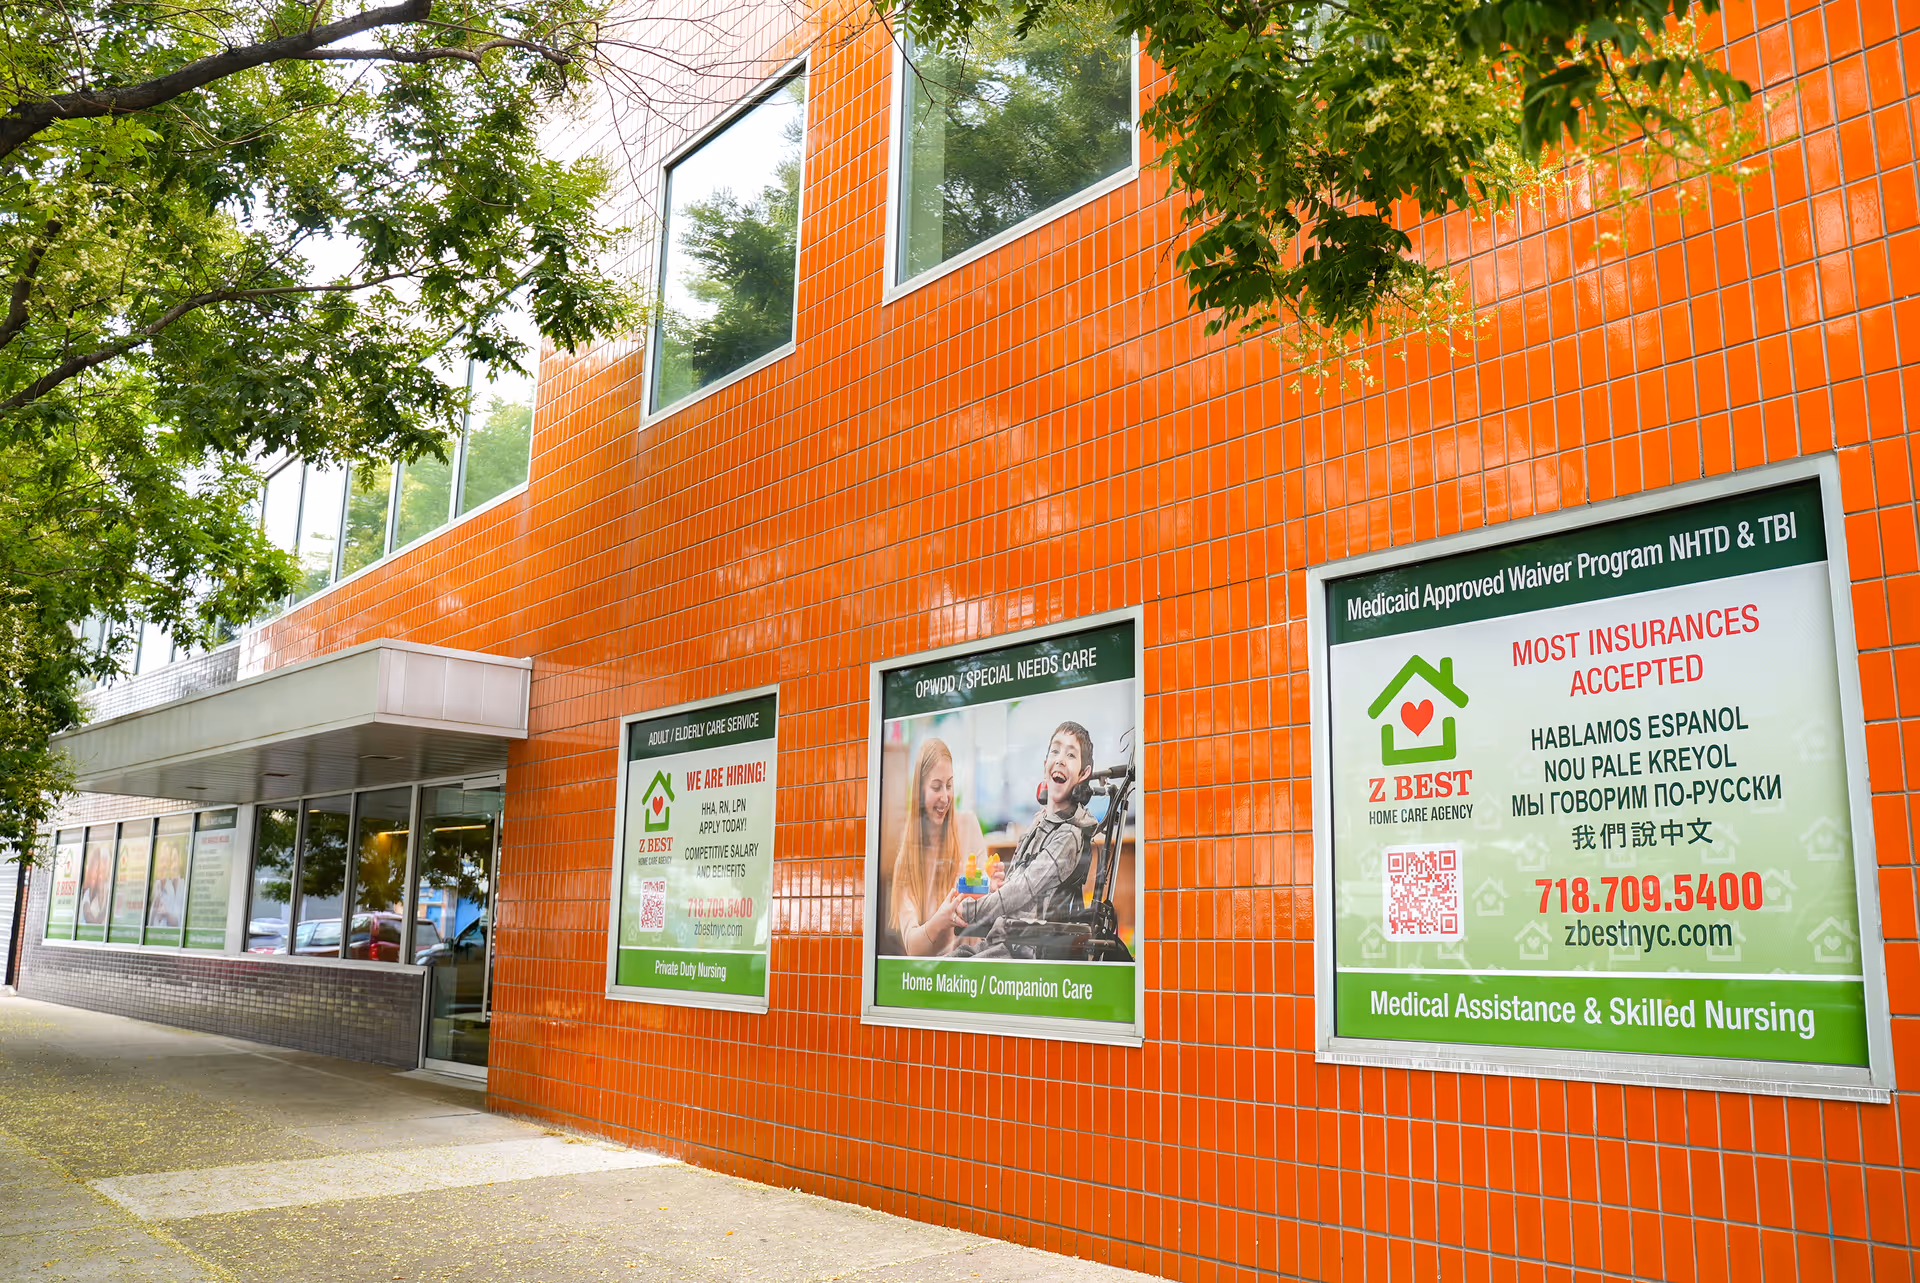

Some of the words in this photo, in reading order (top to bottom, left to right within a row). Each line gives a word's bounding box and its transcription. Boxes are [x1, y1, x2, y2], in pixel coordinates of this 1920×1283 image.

[1347, 583, 1419, 621] Medicaid
[1423, 569, 1504, 610] Approved
[1508, 559, 1572, 593] Waiver
[1577, 542, 1663, 579] Program
[1669, 525, 1730, 561] NHTD
[1737, 521, 1755, 548] &
[1759, 511, 1797, 543] TBI
[1513, 632, 1580, 667] MOST
[1589, 604, 1759, 656] INSURANCES
[916, 675, 955, 698] OPWDD
[958, 674, 964, 691] /
[966, 664, 1013, 689] SPECIAL
[1017, 655, 1058, 679] NEEDS
[1062, 647, 1096, 671] CARE
[1569, 654, 1703, 696] ACCEPTED
[648, 729, 669, 746] ADULT
[670, 728, 674, 742] /
[676, 723, 705, 741] ELDERLY
[706, 719, 725, 736] CARE
[727, 712, 759, 732] SERVICE
[1532, 716, 1641, 750] HABLAMOS
[1649, 706, 1748, 739] ESPANOL
[687, 770, 701, 791] WE
[704, 768, 723, 789] ARE
[727, 761, 766, 786] HIRING!
[1544, 757, 1585, 783] NOU
[1592, 751, 1642, 779] PALE
[1649, 744, 1736, 774] KREYOL
[1369, 778, 1386, 802] Z
[1394, 770, 1472, 801] BEST
[1513, 792, 1544, 817] МЫ
[1551, 782, 1647, 814] ГОВОРИМ
[1655, 775, 1782, 807] ПО-РУССКИ
[701, 802, 717, 816] HHA,
[719, 800, 730, 814] RN,
[733, 799, 746, 812] LPN
[1369, 807, 1399, 824] HOME
[1401, 806, 1428, 823] CARE
[1431, 804, 1473, 821] AGENCY
[699, 821, 721, 834] APPLY
[722, 818, 746, 832] TODAY!
[1572, 817, 1713, 850] 我們說中文
[638, 857, 648, 865] HOME
[649, 857, 657, 865] CARE
[658, 856, 672, 864] AGENCY
[639, 839, 645, 853] Z
[648, 837, 673, 852] BEST
[685, 845, 728, 860] COMPETITIVE
[731, 843, 759, 858] SALARY
[696, 865, 711, 878] AND
[712, 864, 745, 877] BENEFITS
[688, 898, 752, 917] 718.709.5400
[1535, 871, 1763, 913] 718.709.5400
[694, 922, 742, 939] zbestnyc.com
[1565, 919, 1732, 952] zbestnyc.com
[655, 960, 678, 976] Private
[680, 962, 696, 979] Duty
[698, 963, 726, 981] Nursing
[902, 972, 932, 991] Home
[936, 974, 977, 998] Making
[981, 976, 986, 994] /
[989, 976, 1058, 1000] Companion
[1062, 979, 1093, 999] Care
[1370, 990, 1449, 1018] Medical
[1455, 993, 1575, 1023] Assistance
[1584, 999, 1601, 1023] &
[1610, 996, 1695, 1029] Skilled
[1705, 1000, 1815, 1039] Nursing
